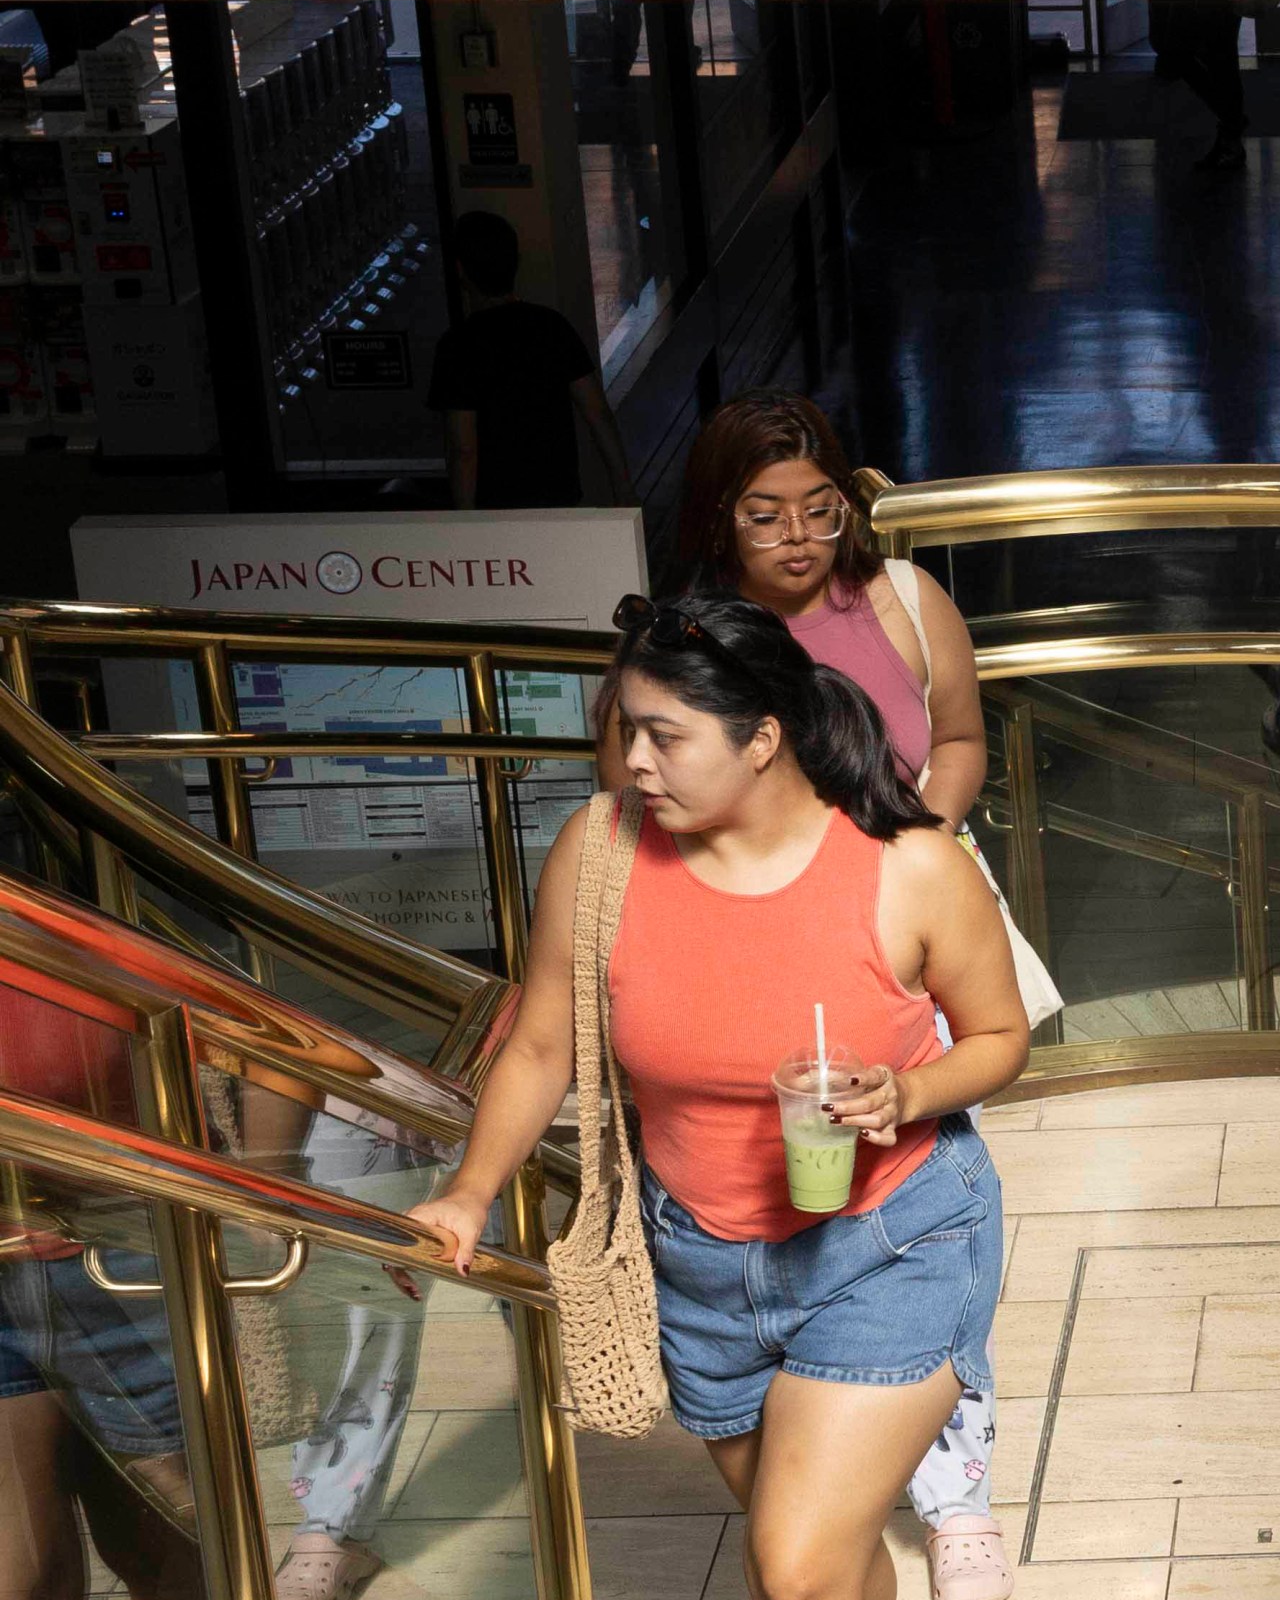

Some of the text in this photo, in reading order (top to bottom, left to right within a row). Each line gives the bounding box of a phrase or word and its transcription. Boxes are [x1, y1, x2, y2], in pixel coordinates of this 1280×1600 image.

[190, 555, 535, 600] JAPAN CENTER
[367, 890, 392, 904] TO
[397, 889, 480, 905] JAPANESE
[464, 911, 475, 923] &
